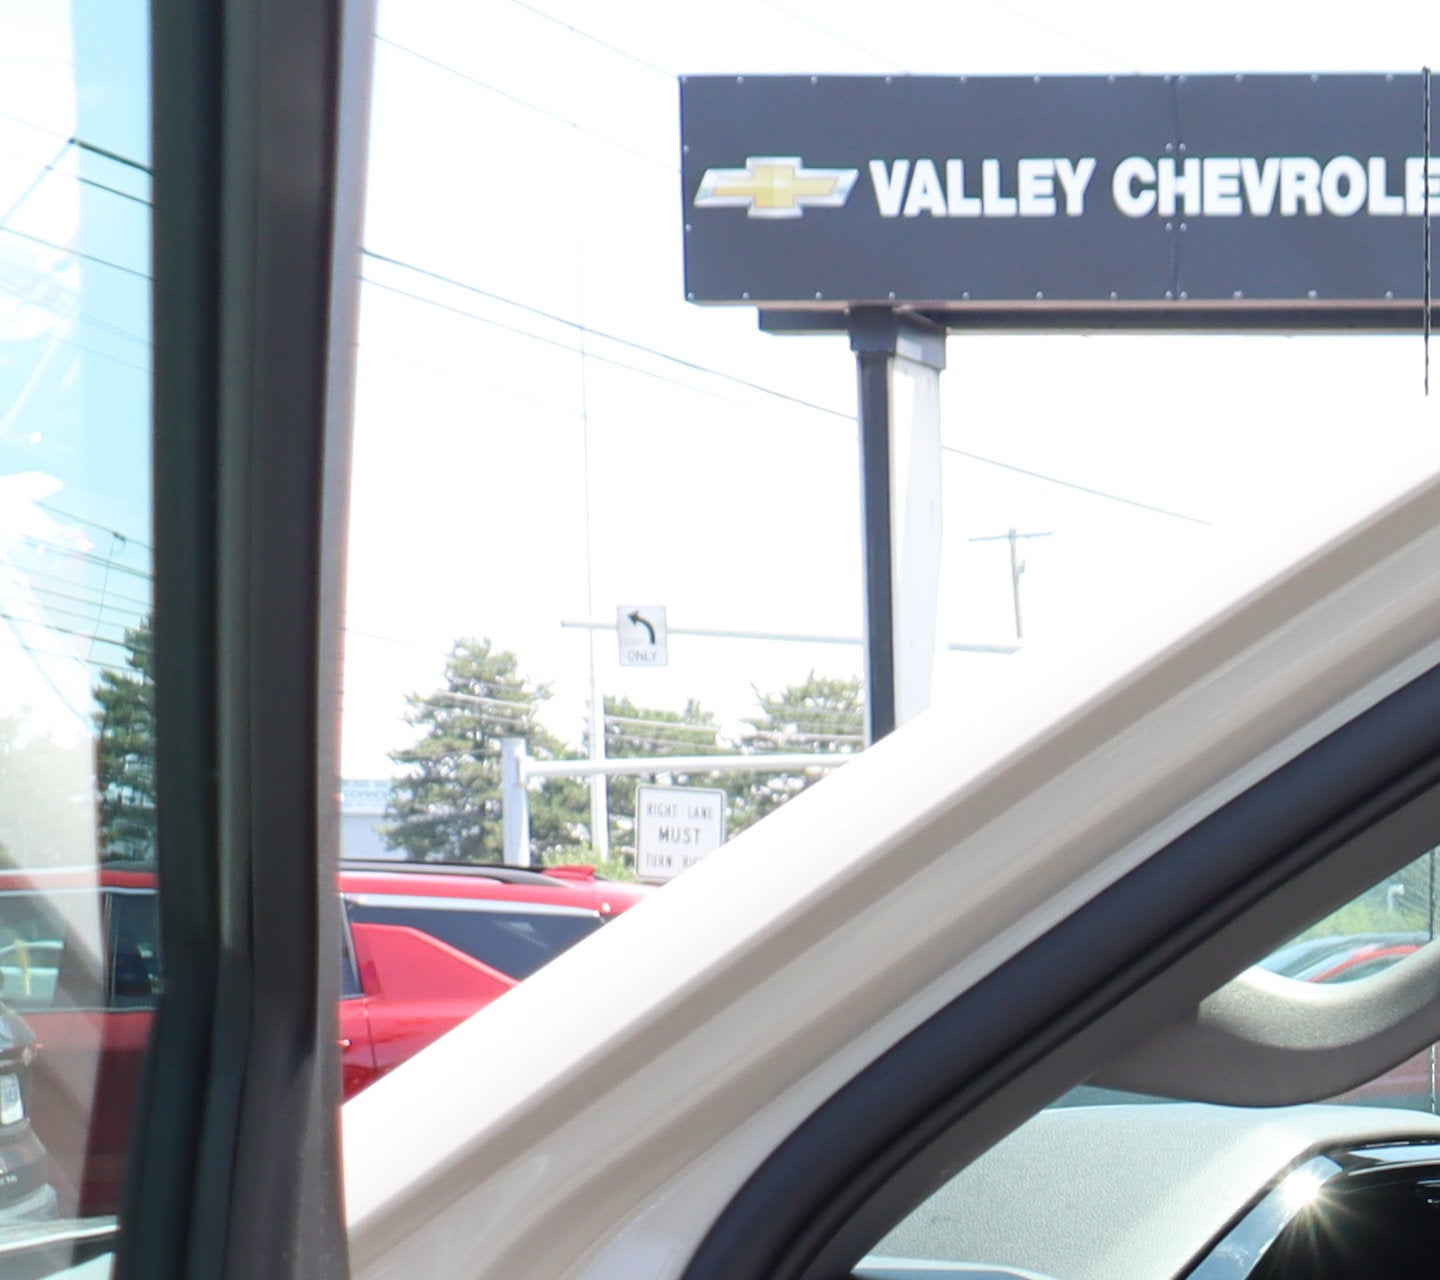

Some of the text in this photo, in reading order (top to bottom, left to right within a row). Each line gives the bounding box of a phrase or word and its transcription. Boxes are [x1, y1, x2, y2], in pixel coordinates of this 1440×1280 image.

[870, 157, 1095, 217] VALLEY
[627, 649, 658, 662] ONLY
[646, 801, 714, 821] RIGHT LANE
[657, 826, 701, 844] MUST
[645, 853, 673, 868] TURN
